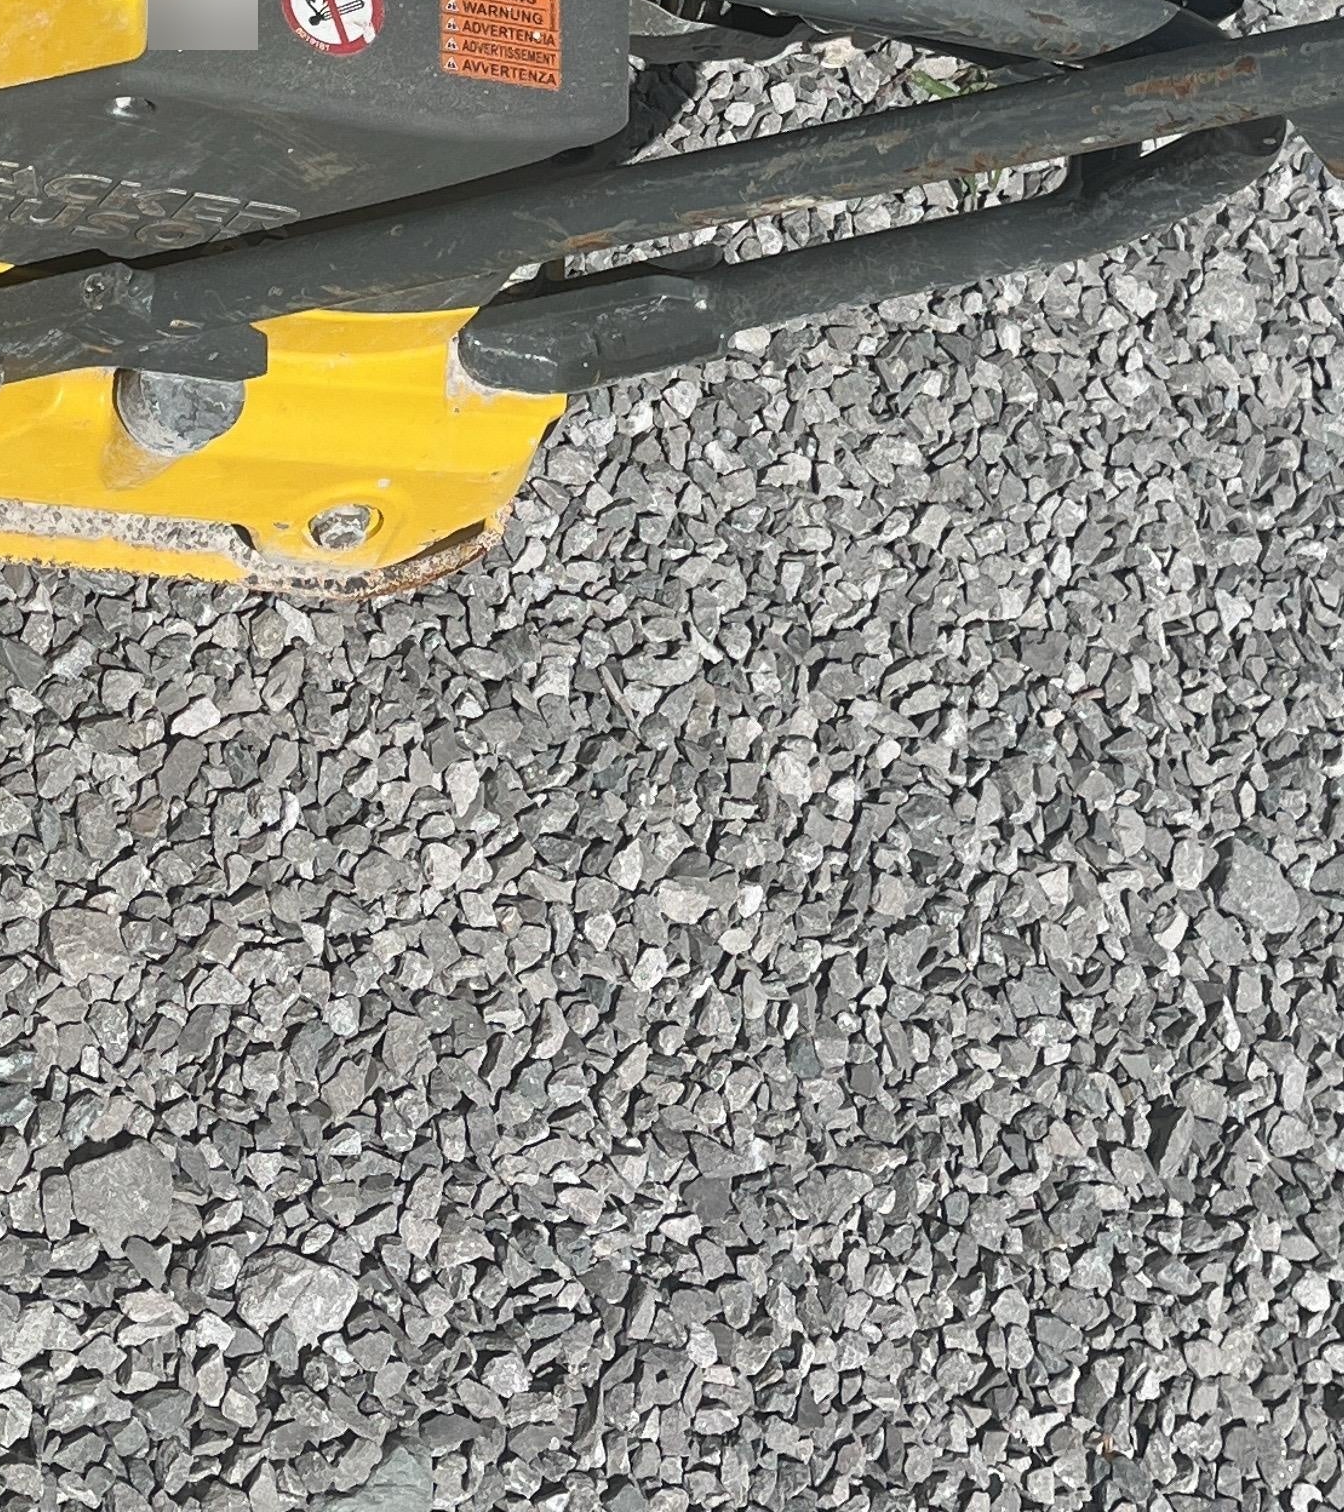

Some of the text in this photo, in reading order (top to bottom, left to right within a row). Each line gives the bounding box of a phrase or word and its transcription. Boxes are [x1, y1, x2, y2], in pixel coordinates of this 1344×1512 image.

[462, 0, 543, 25] WARNUNG
[462, 40, 556, 65] ADVERTISSEMENT
[462, 59, 557, 86] AVVERTENZA
